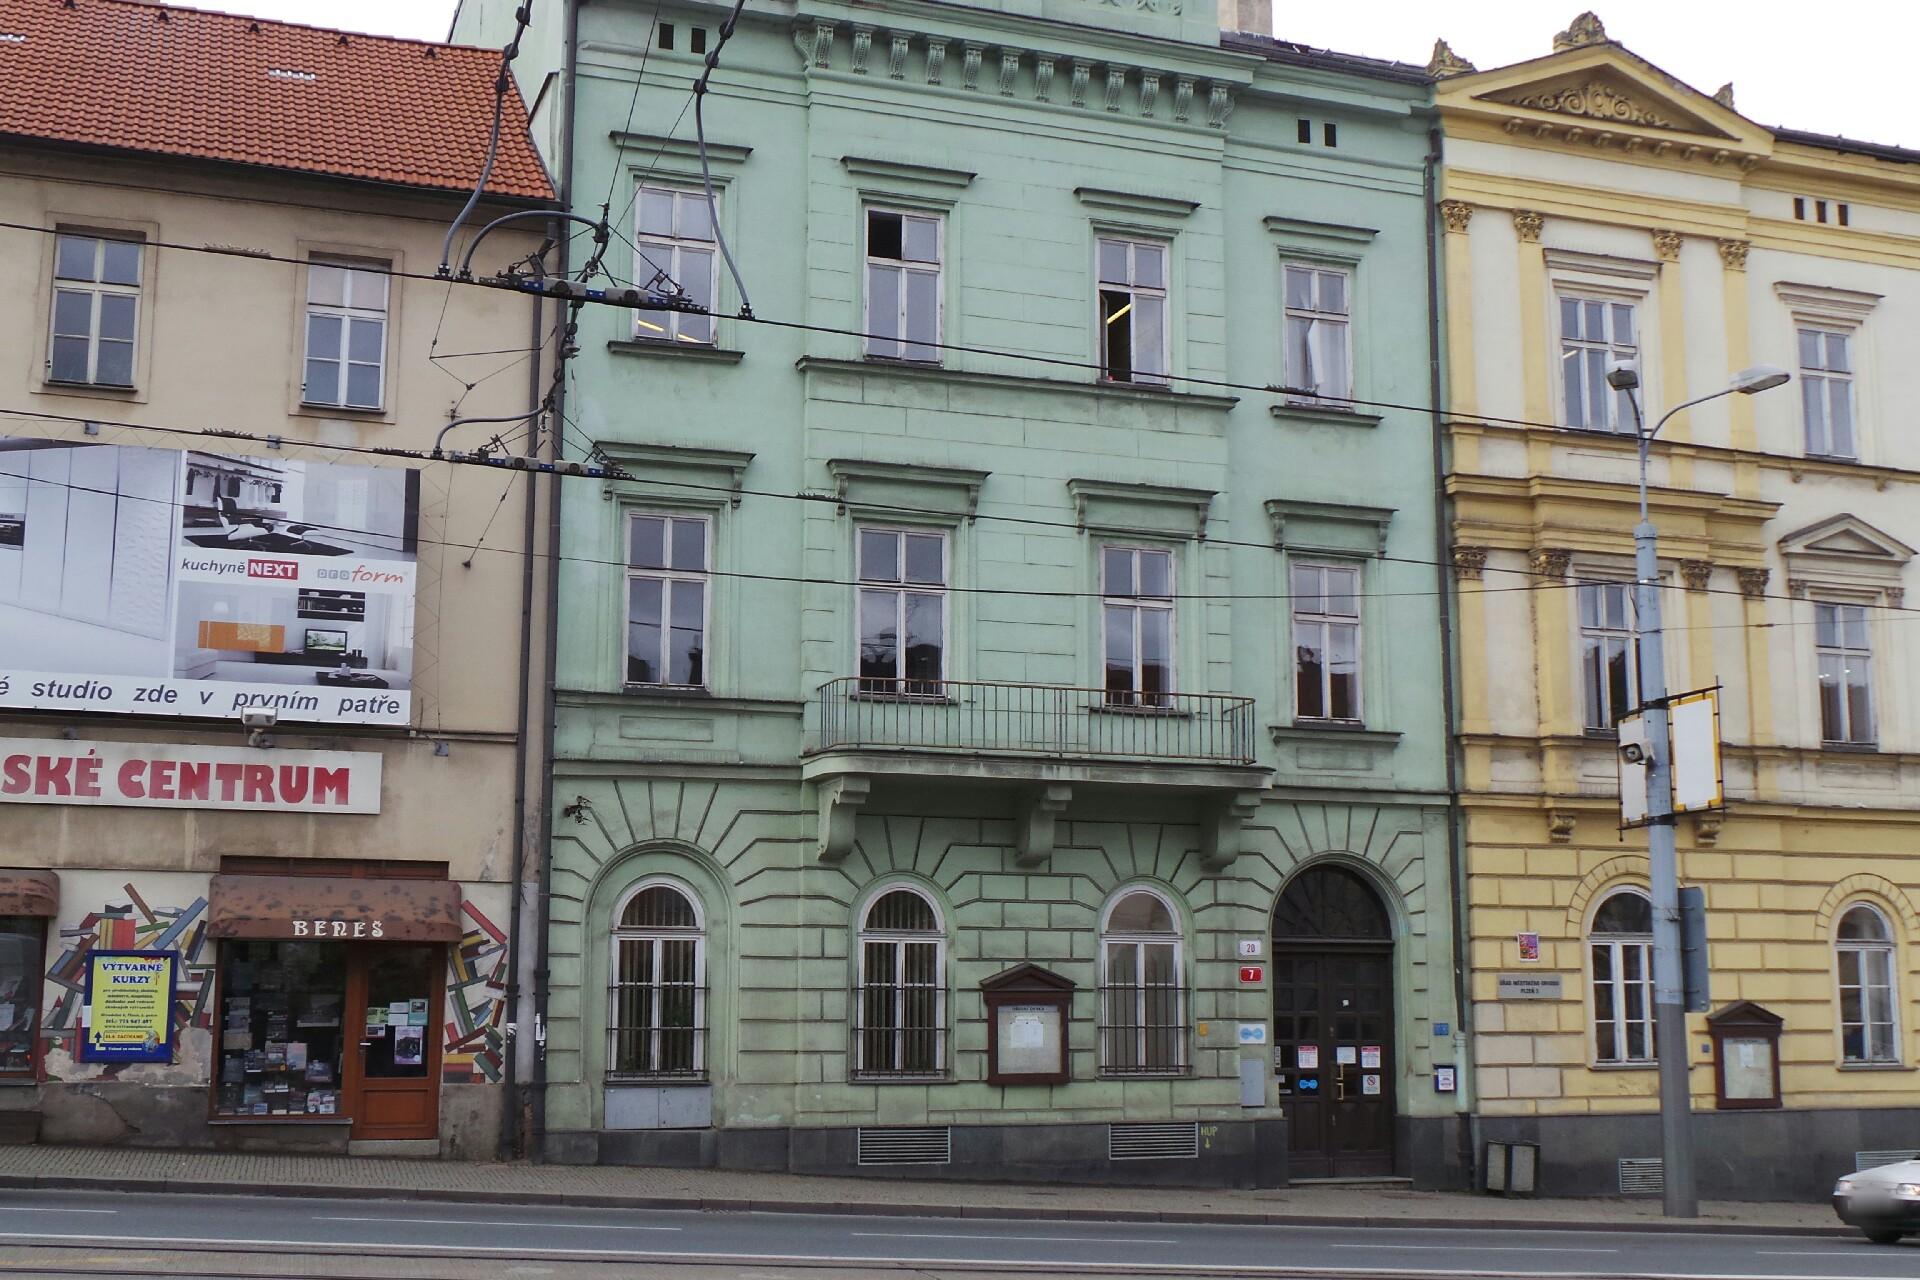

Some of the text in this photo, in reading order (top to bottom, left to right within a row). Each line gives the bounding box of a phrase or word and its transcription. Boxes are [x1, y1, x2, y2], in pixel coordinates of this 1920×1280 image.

[181, 558, 296, 577] kuchyně NEXT
[31, 680, 113, 700] studio
[133, 685, 178, 703] zde
[199, 690, 214, 705] v
[232, 691, 319, 711] prvním
[337, 695, 400, 716] patře
[1, 749, 350, 806] SKÉ CENTRUM
[292, 920, 384, 938] BENEŠ
[102, 961, 164, 972] VÝTVARNÉ
[1248, 969, 1254, 980] 7
[112, 975, 151, 984] KURZY
